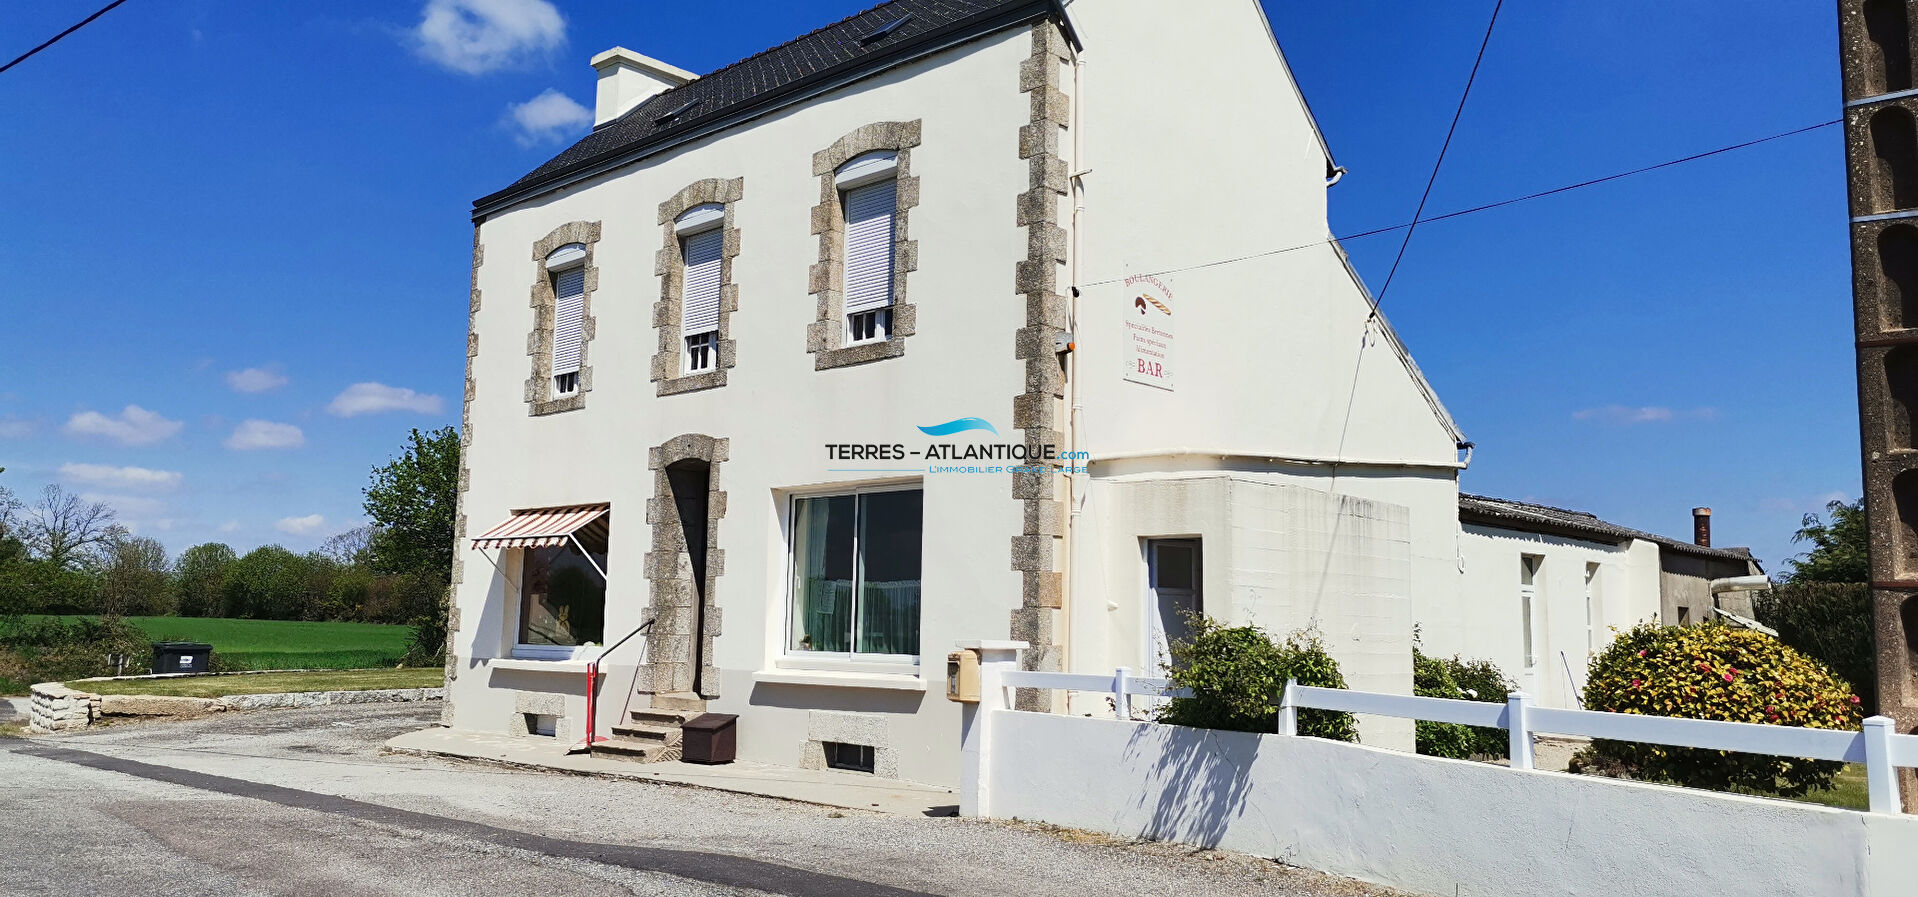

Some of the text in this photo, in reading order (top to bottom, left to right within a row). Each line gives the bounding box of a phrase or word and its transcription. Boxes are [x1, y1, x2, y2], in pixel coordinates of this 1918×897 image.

[1124, 274, 1174, 300] BOULANGERIE
[1136, 345, 1165, 359] Alimentation
[1137, 358, 1163, 378] BAR
